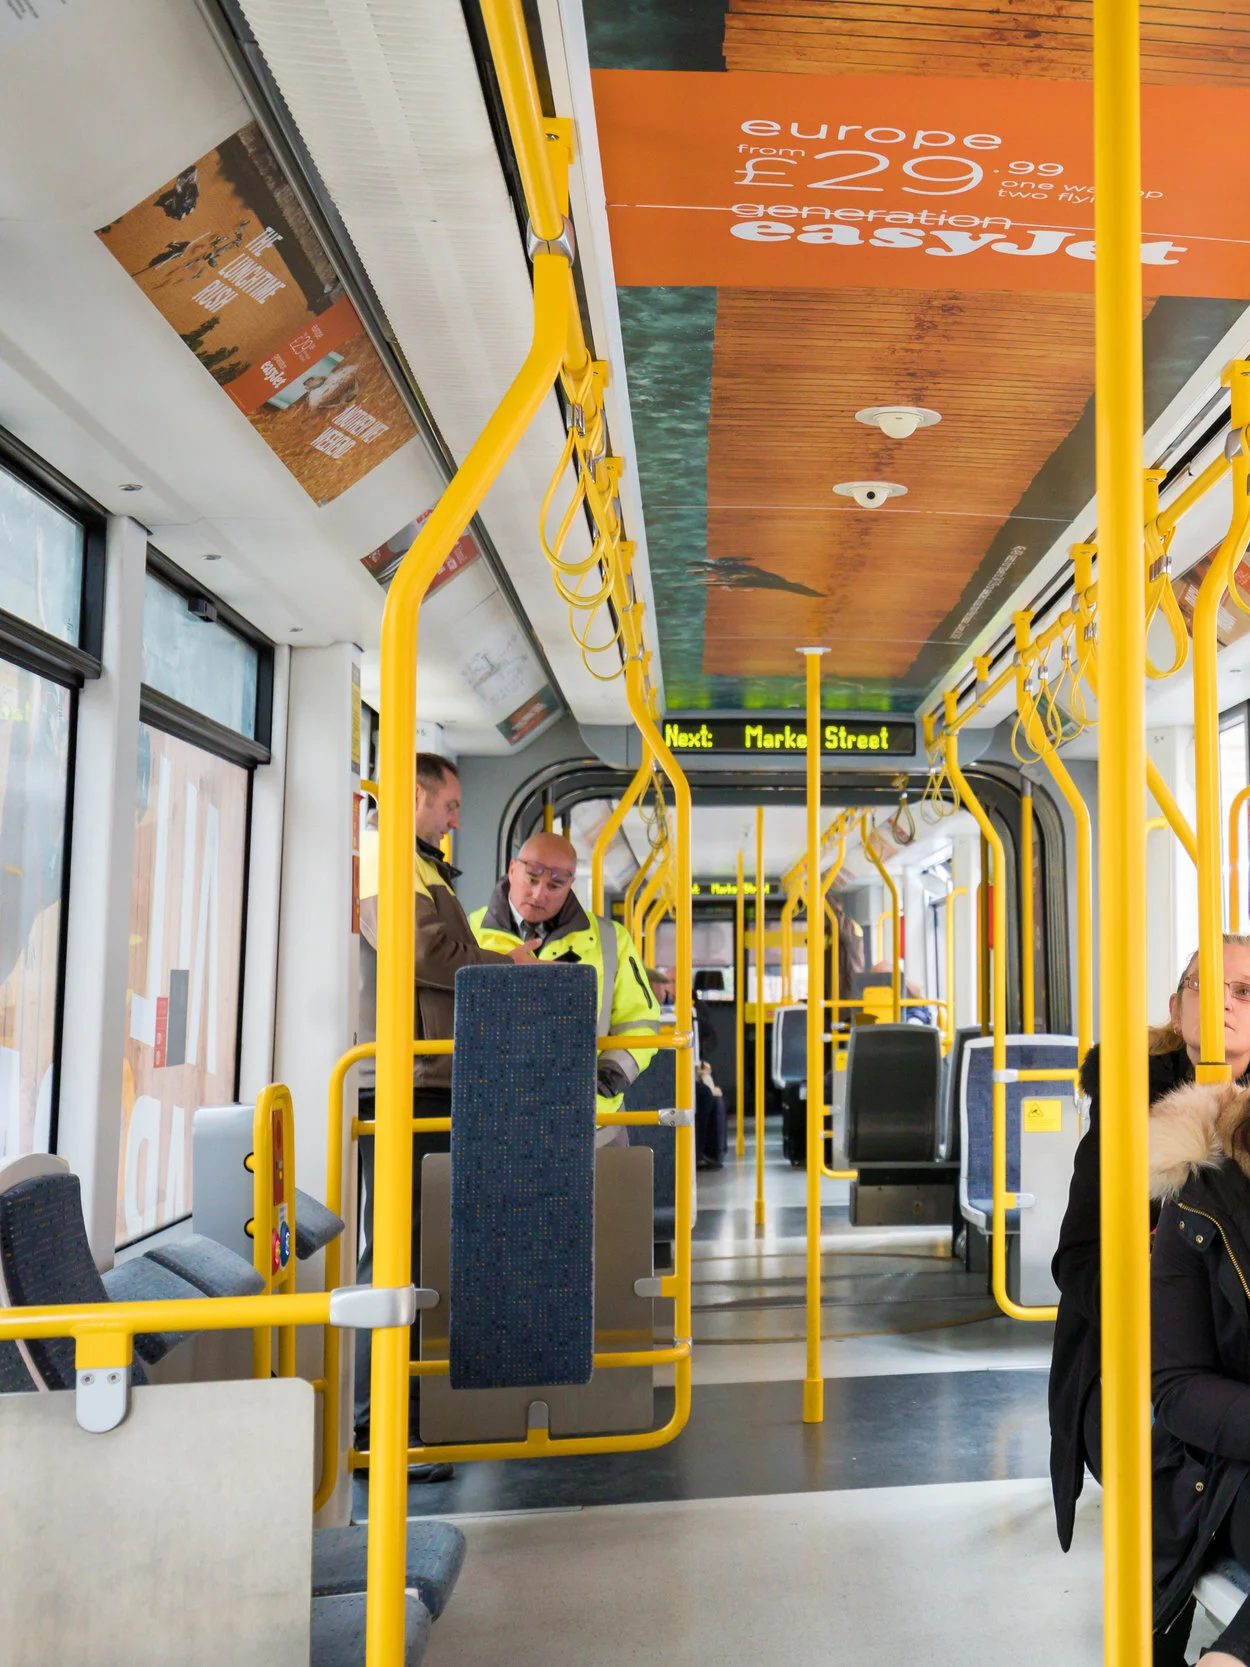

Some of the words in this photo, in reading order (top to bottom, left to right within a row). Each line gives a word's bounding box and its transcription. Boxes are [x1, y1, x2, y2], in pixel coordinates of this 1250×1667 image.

[741, 119, 1002, 150] europe
[737, 143, 806, 157] from
[997, 188, 1049, 200] two
[1001, 180, 1055, 190] one
[1063, 183, 1096, 194] wa
[731, 203, 1012, 230] generation
[245, 226, 284, 257] THE
[218, 252, 287, 304] LUNCHTIME
[191, 279, 240, 313] RUSH
[665, 723, 713, 749] Next:
[745, 724, 808, 750] Marke
[825, 725, 889, 750] Street
